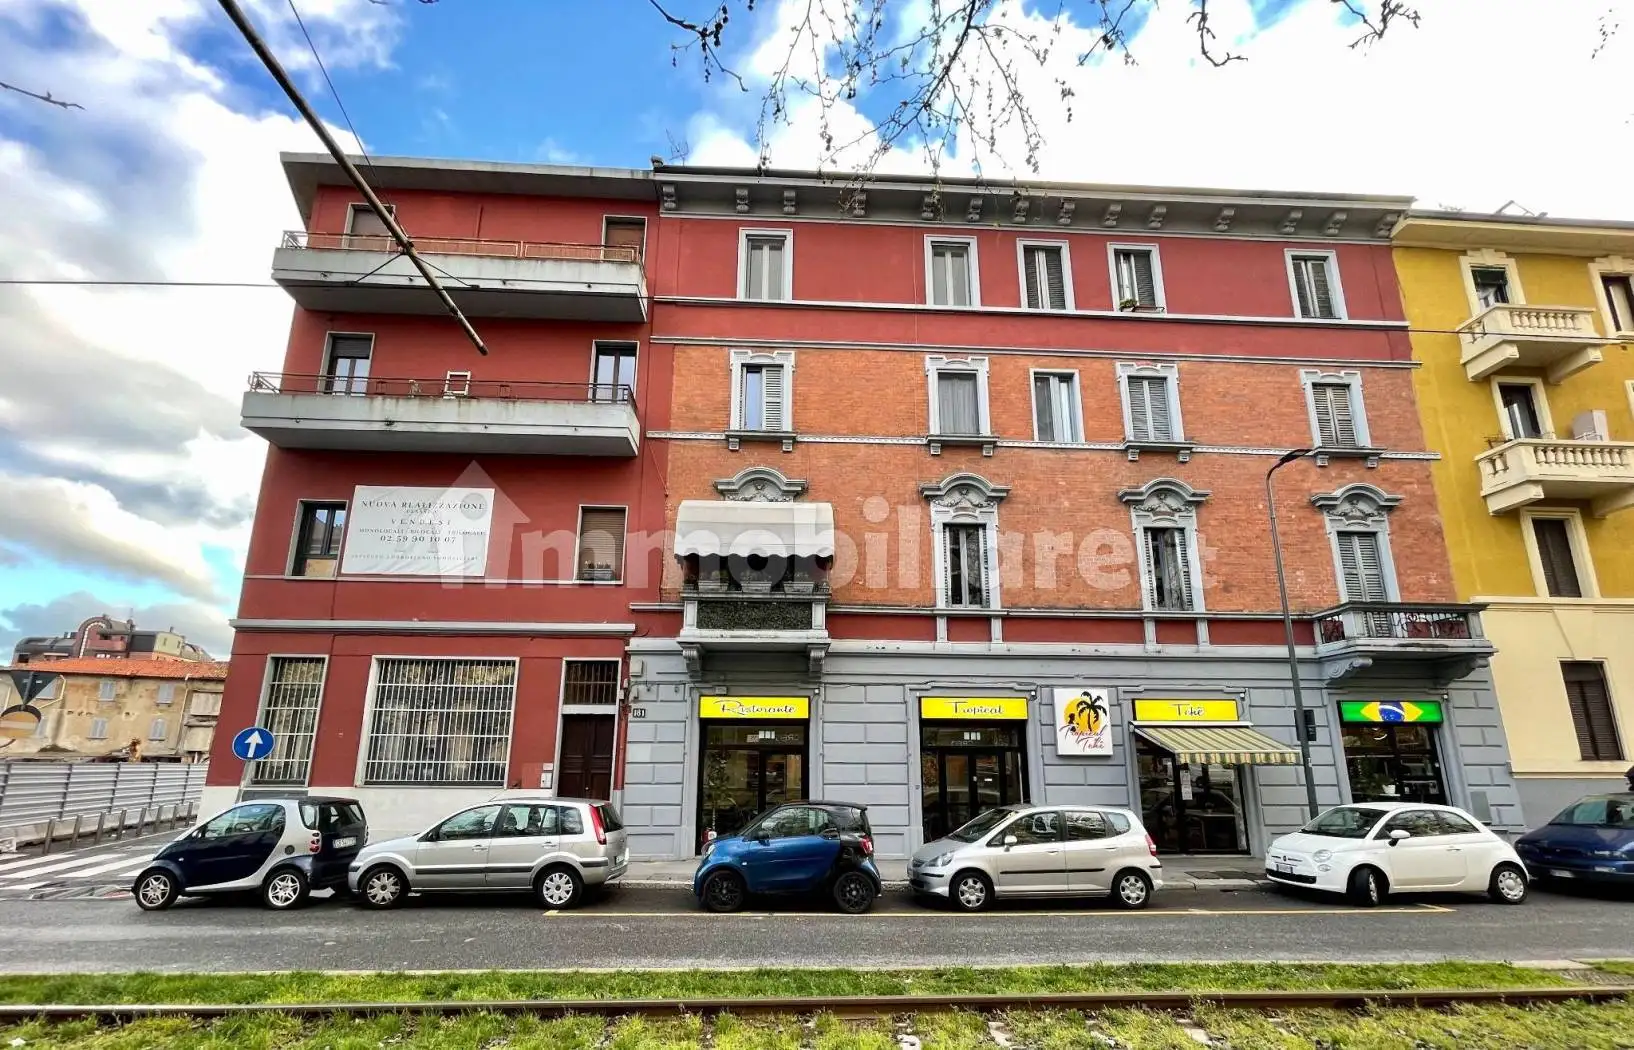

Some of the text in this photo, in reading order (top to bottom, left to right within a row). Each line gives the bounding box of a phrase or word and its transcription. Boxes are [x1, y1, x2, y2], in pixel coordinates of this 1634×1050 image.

[362, 500, 397, 508] NUOVA
[713, 699, 795, 715] Ristorante
[943, 701, 1002, 715] Tropical
[1058, 724, 1107, 742] Tropical
